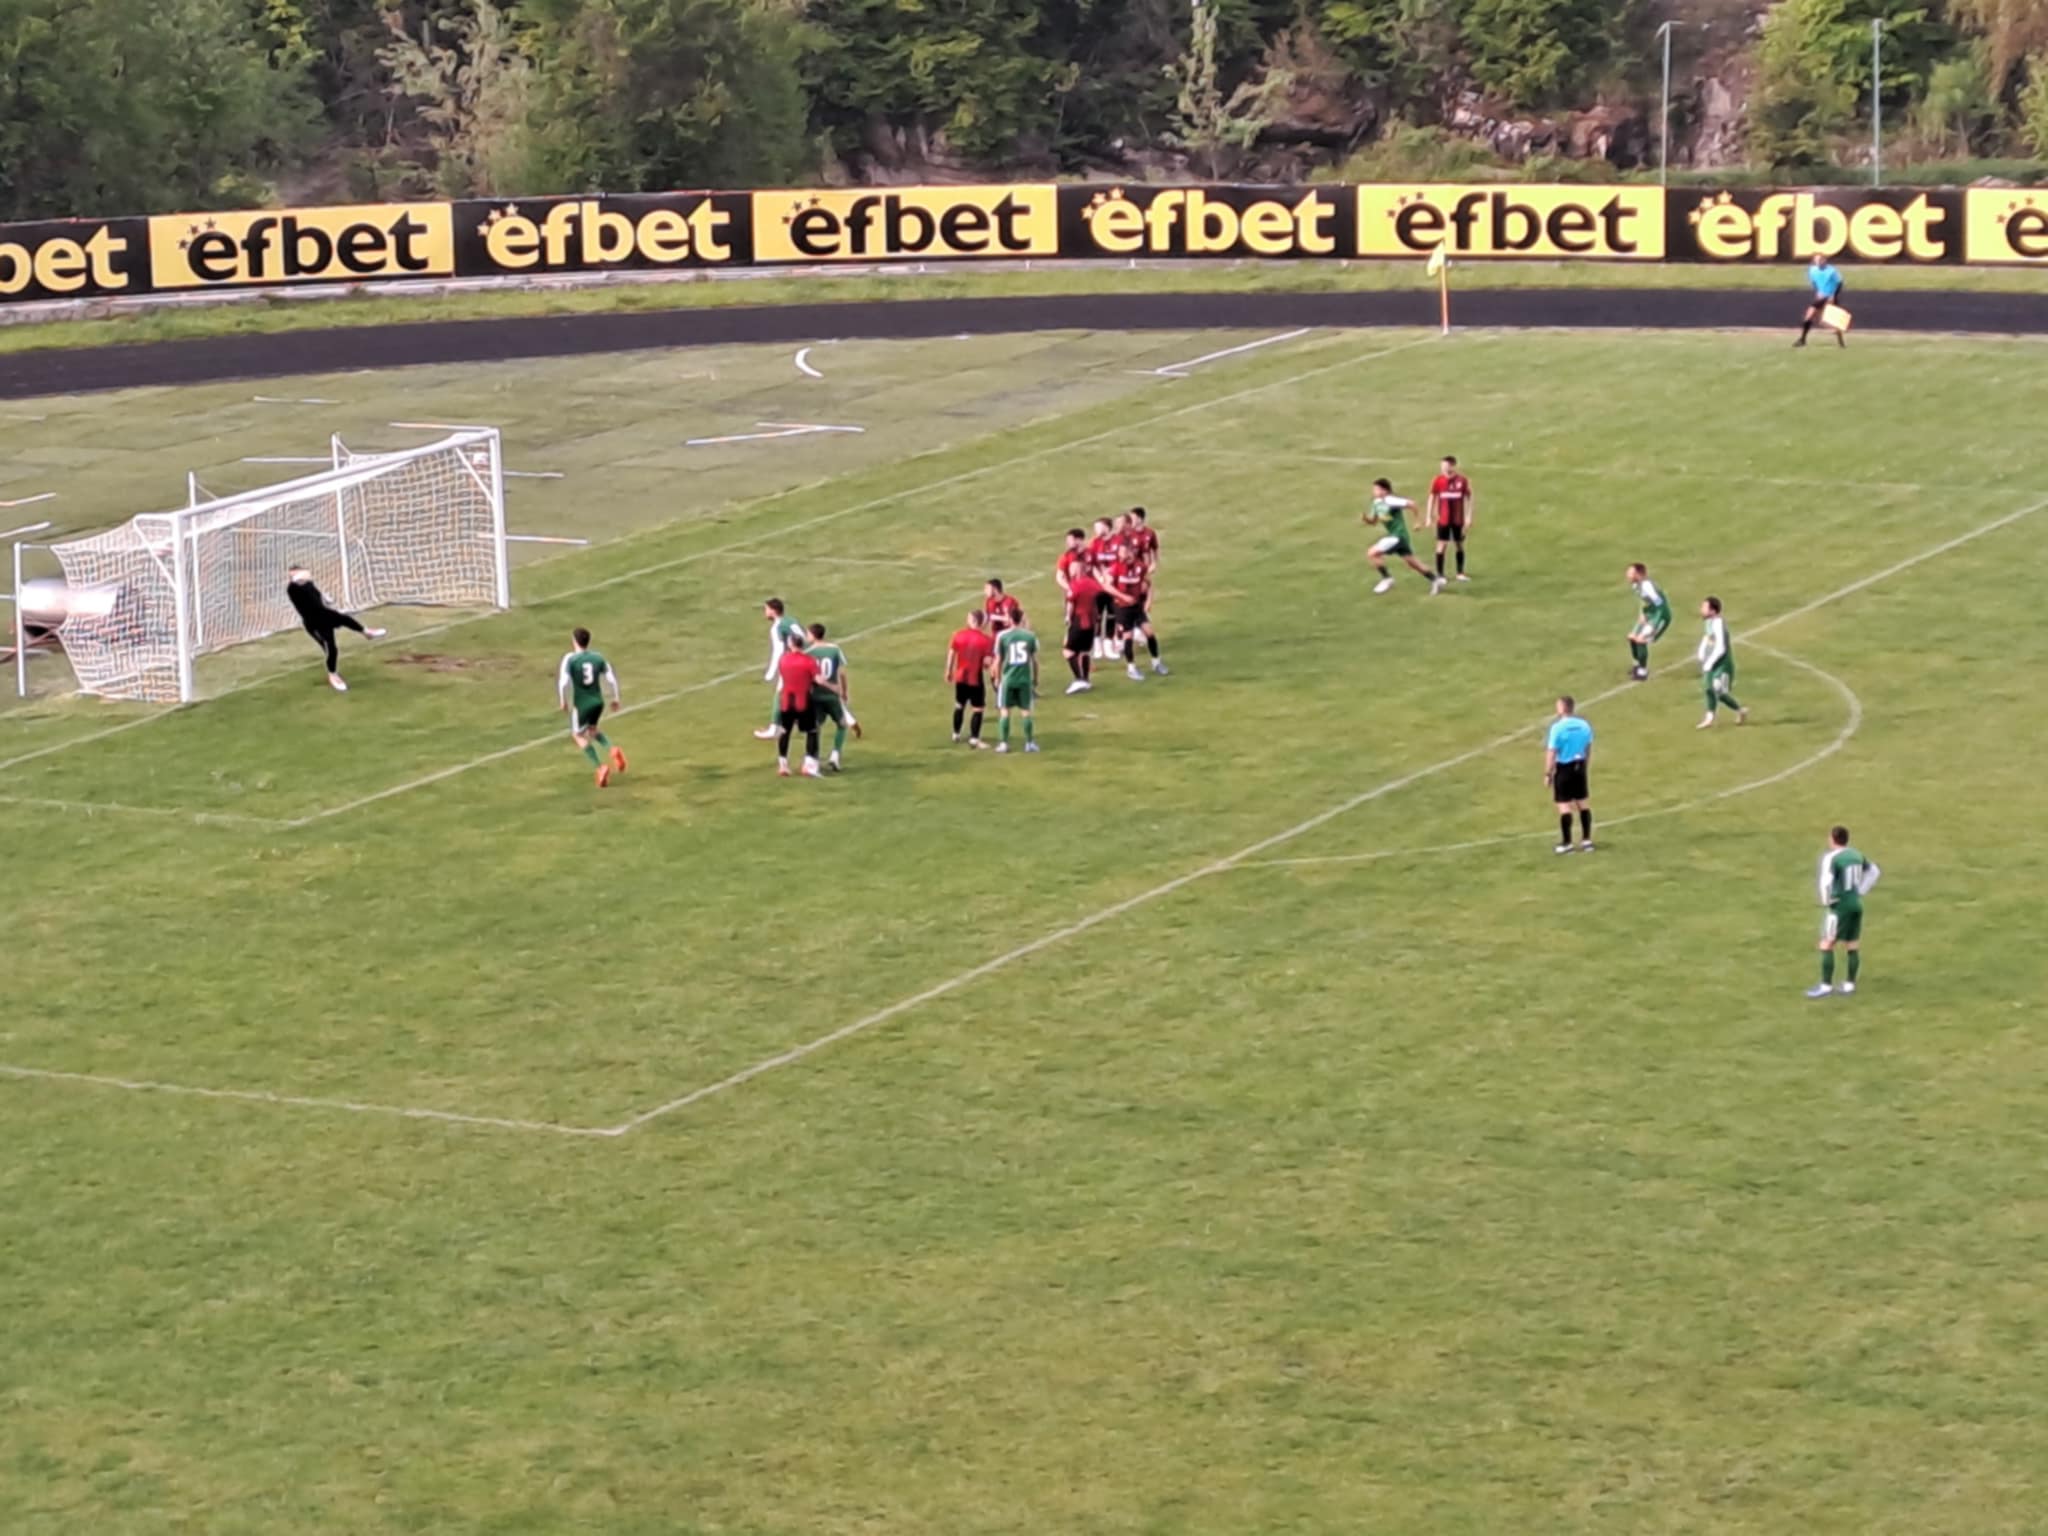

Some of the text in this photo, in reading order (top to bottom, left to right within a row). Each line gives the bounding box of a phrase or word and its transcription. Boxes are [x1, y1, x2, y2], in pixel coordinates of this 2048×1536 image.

[186, 212, 428, 281] efbet
[486, 198, 731, 268] efbet
[789, 192, 1031, 254] efbet
[1090, 189, 1335, 252] efbet
[1394, 192, 1638, 253] efbet
[1696, 193, 1945, 258] efbet
[582, 662, 594, 685] 3
[1009, 641, 1027, 664] 15
